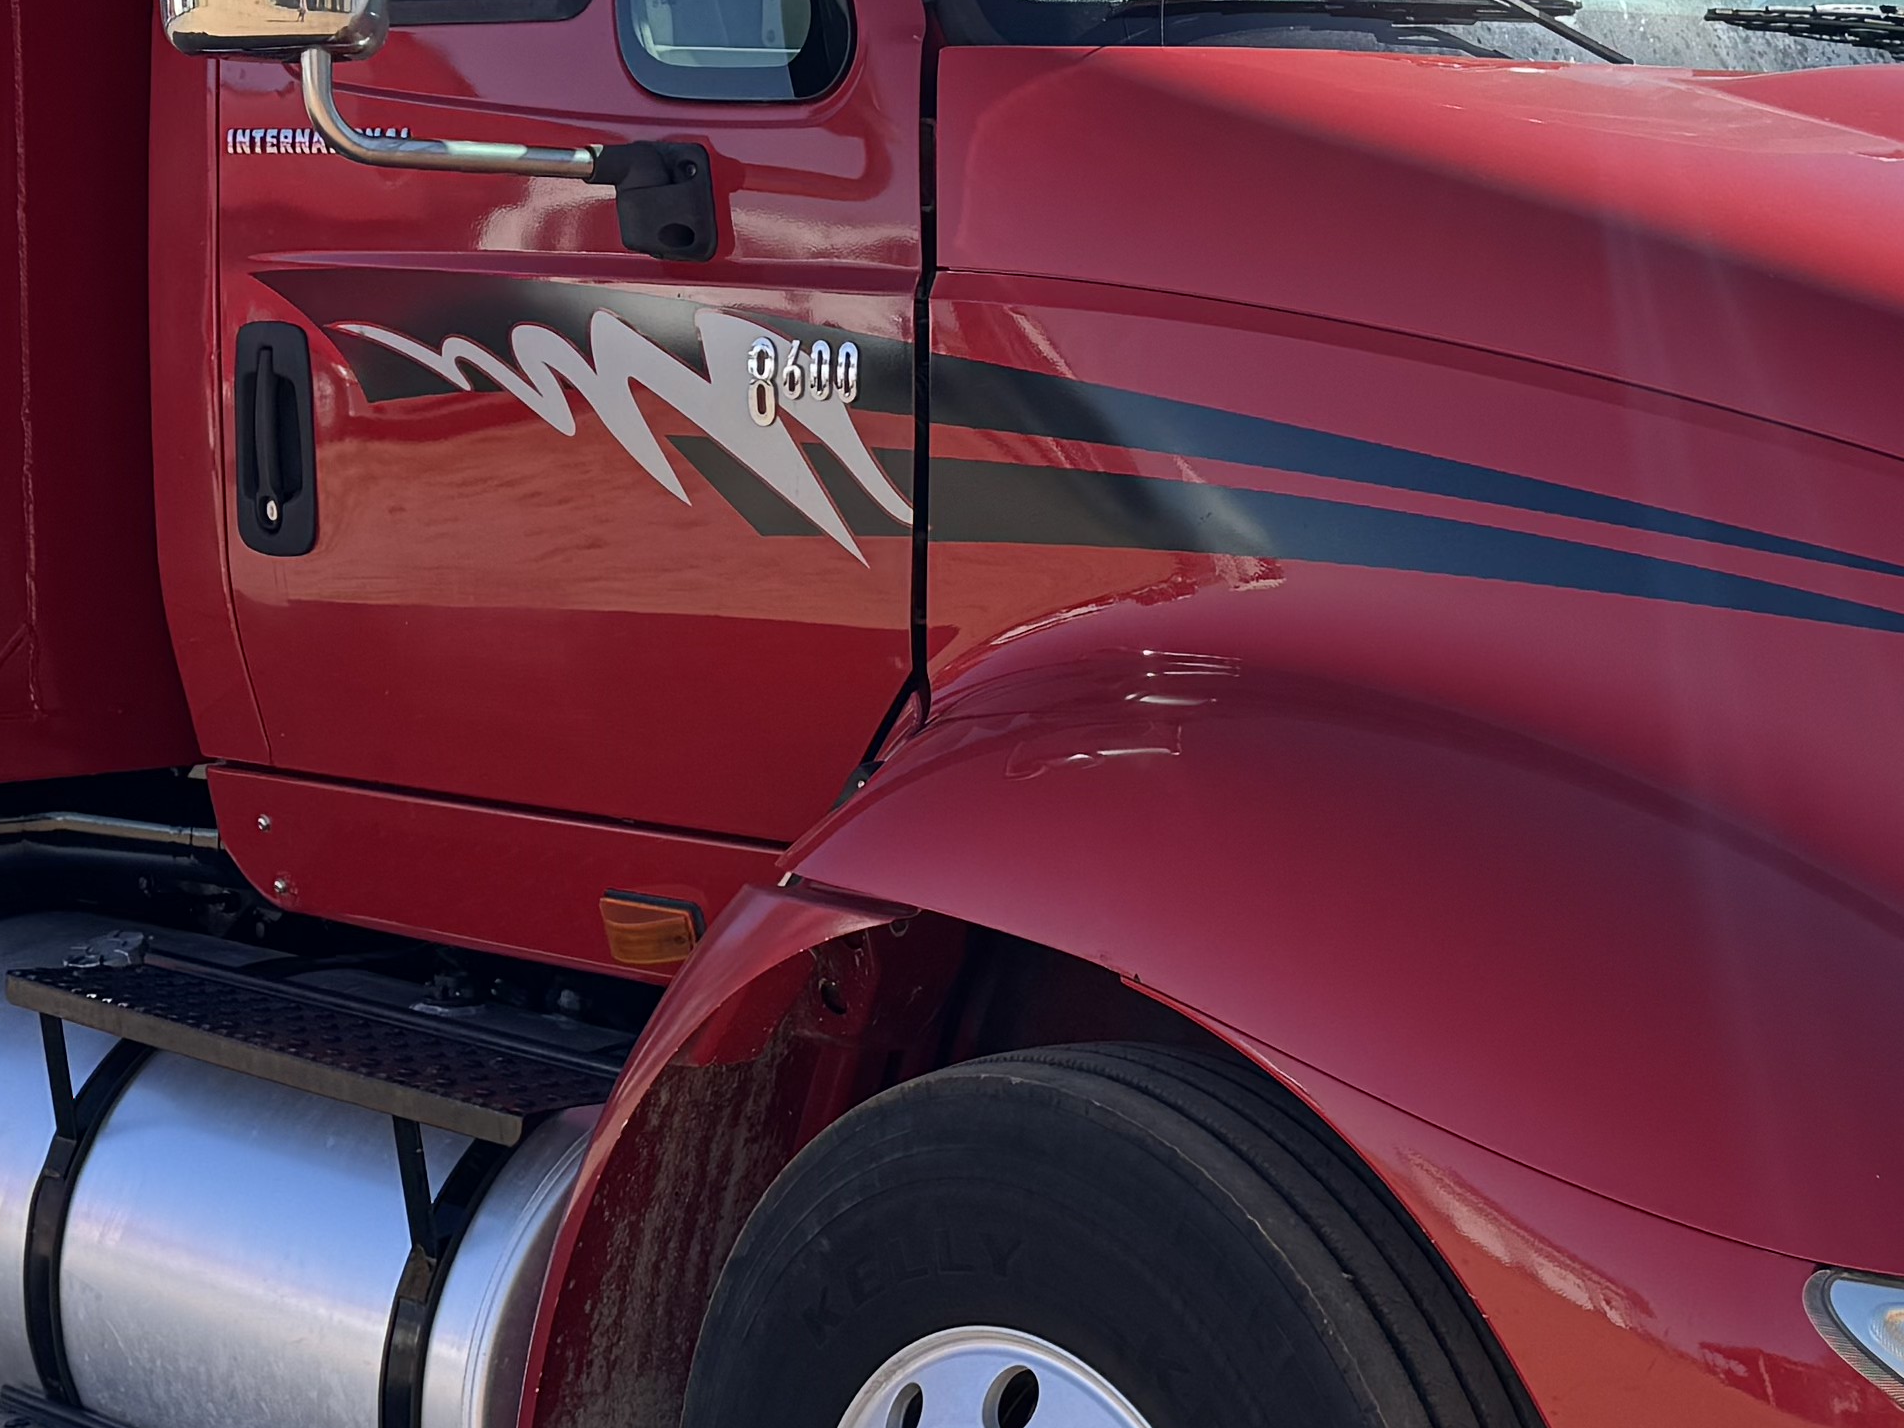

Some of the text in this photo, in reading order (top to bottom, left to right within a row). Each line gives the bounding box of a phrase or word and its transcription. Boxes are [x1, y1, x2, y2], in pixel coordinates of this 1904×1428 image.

[227, 128, 411, 154] INTERNA
[748, 336, 859, 427] 8600
[801, 1227, 1027, 1350] KELLY
